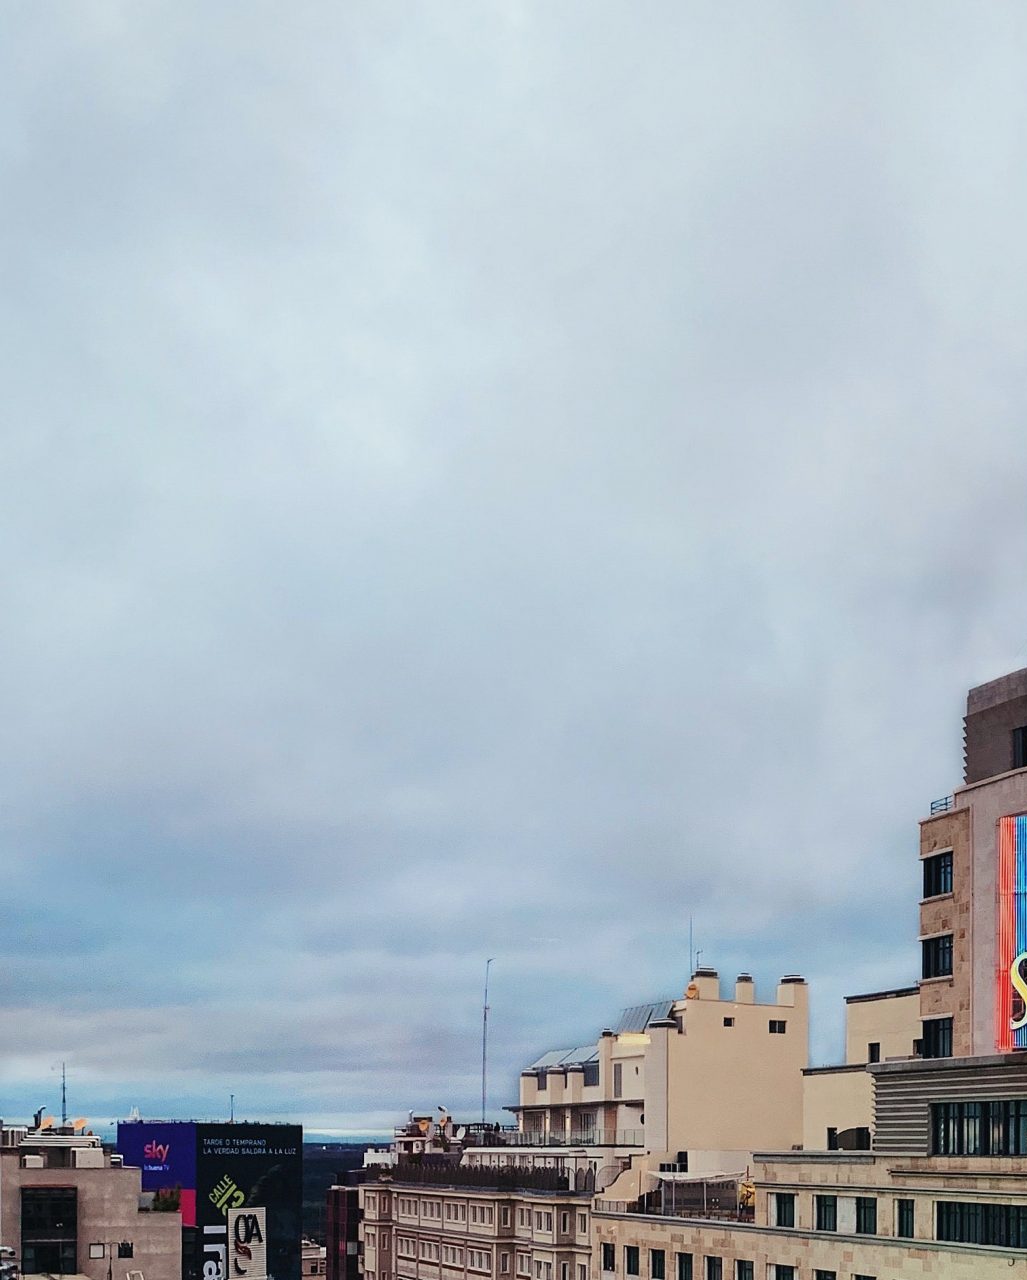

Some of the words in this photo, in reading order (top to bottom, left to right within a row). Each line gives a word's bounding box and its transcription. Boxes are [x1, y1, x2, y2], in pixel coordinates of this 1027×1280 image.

[203, 1138, 223, 1146] TARDE
[225, 1138, 230, 1146] O
[232, 1138, 267, 1146] TEMPRANO
[144, 1139, 170, 1162] sky
[203, 1147, 212, 1155] LA
[214, 1147, 240, 1155] VERDAD
[268, 1147, 273, 1155] A
[274, 1147, 283, 1155] LA
[285, 1147, 296, 1155] LUZ
[208, 1173, 233, 1204] CALLE
